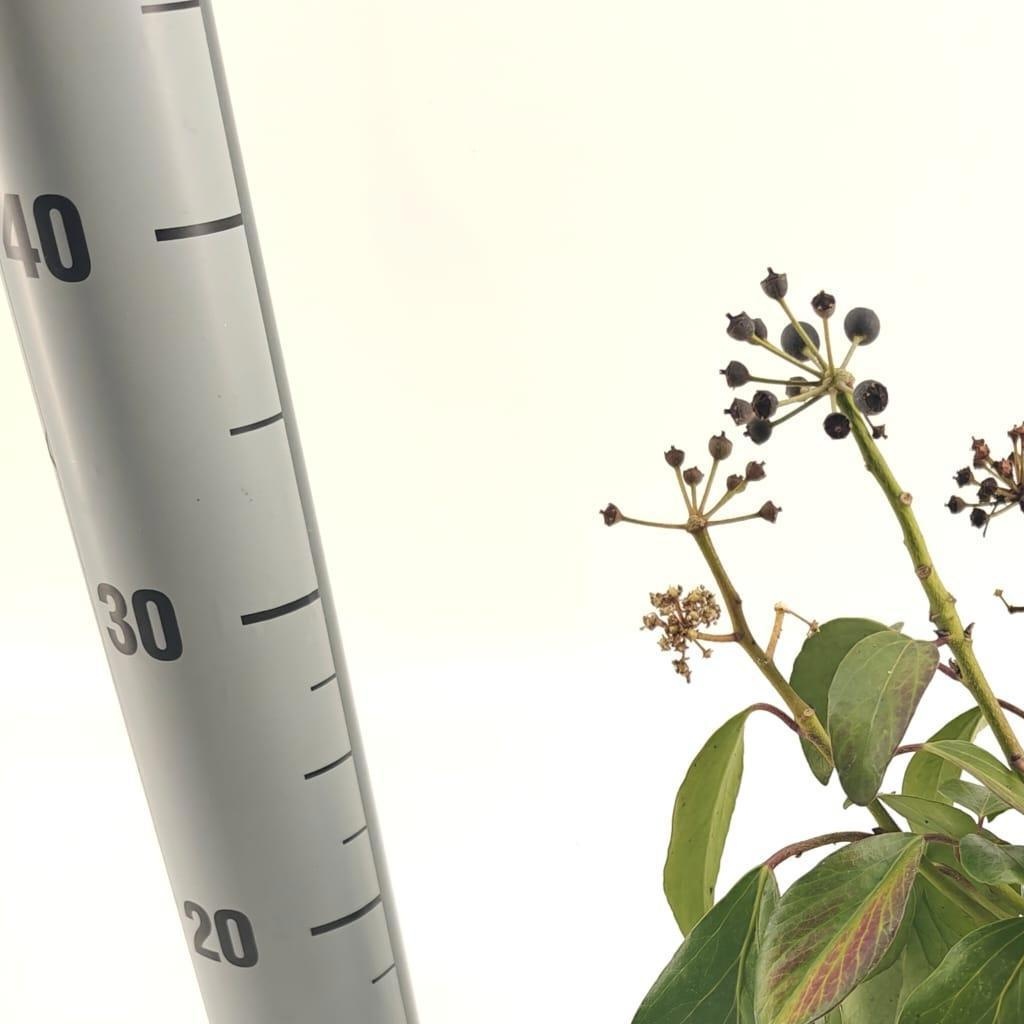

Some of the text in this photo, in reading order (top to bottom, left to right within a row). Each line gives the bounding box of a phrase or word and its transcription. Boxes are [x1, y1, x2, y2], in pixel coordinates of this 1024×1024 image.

[2, 193, 92, 283] 40
[97, 583, 184, 662] 30
[184, 900, 259, 968] 20
